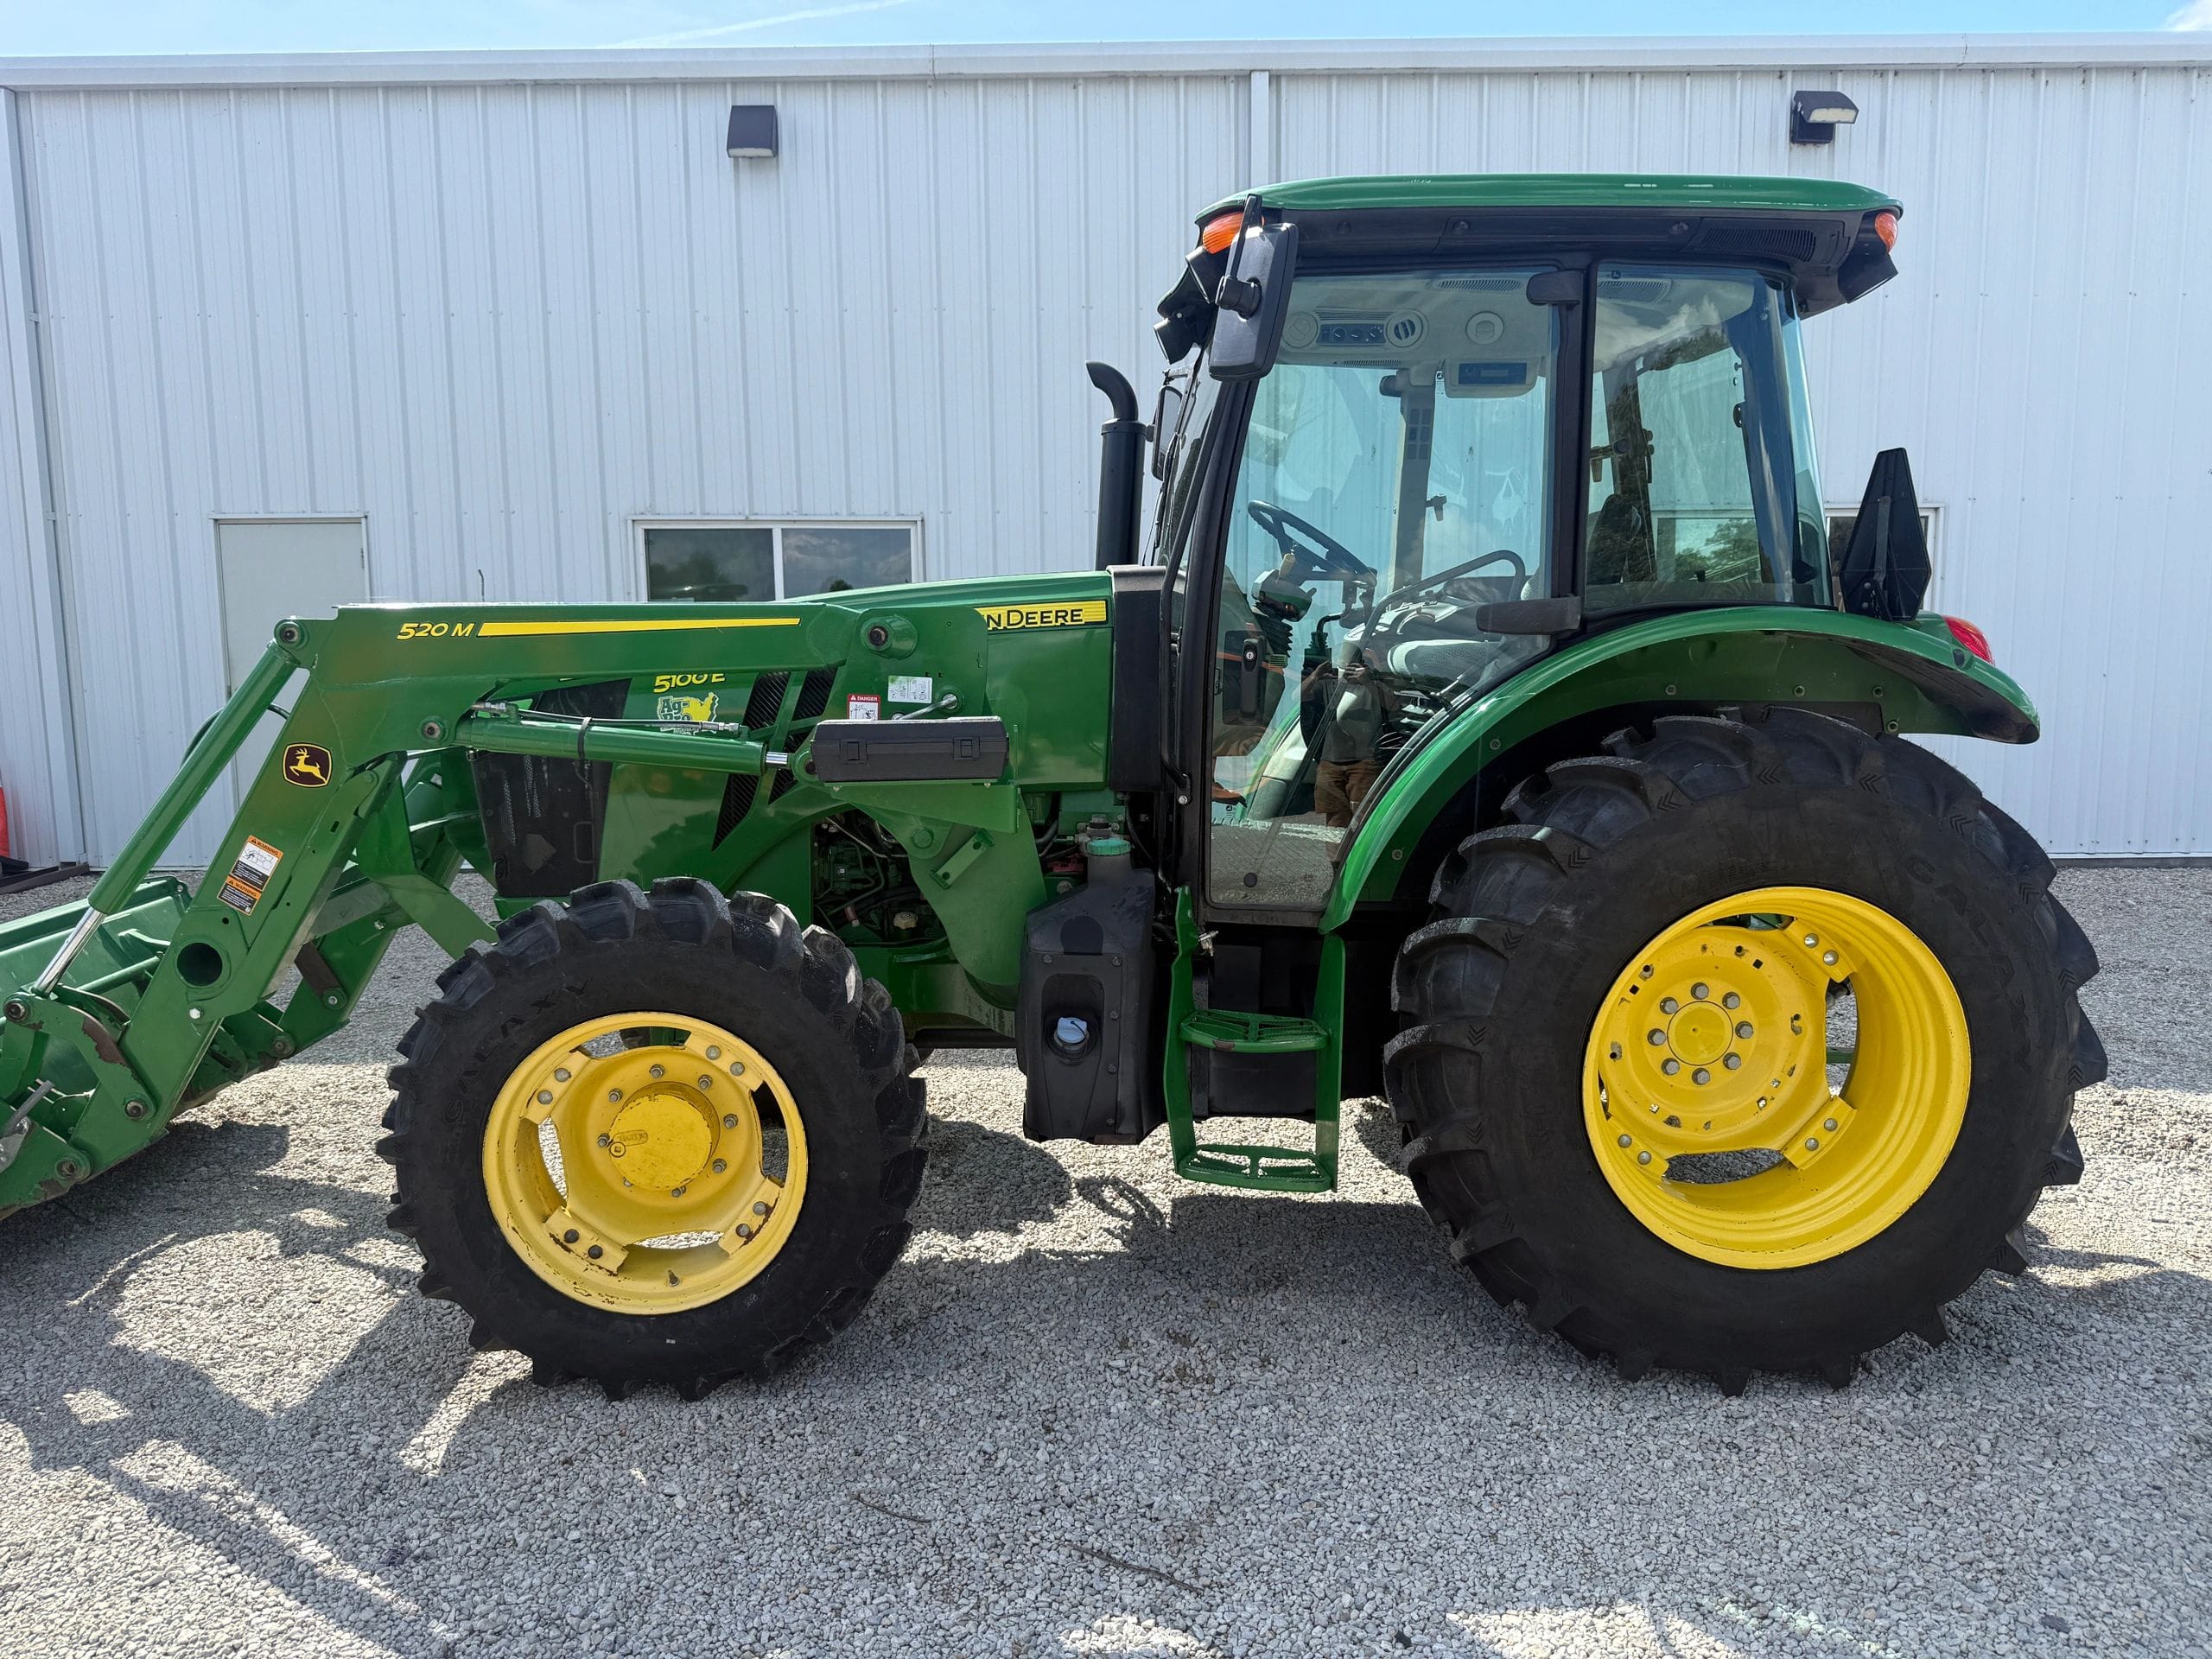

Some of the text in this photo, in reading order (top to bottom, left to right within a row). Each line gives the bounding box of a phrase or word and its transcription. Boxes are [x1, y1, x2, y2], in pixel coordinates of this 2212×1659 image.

[1007, 609, 1084, 626] DEERE
[397, 622, 475, 639] 520 M
[257, 841, 278, 855] WARNING
[235, 882, 257, 897] WARNING
[1906, 856, 2031, 1073] GALAXY
[443, 980, 591, 1125] GALAXY
